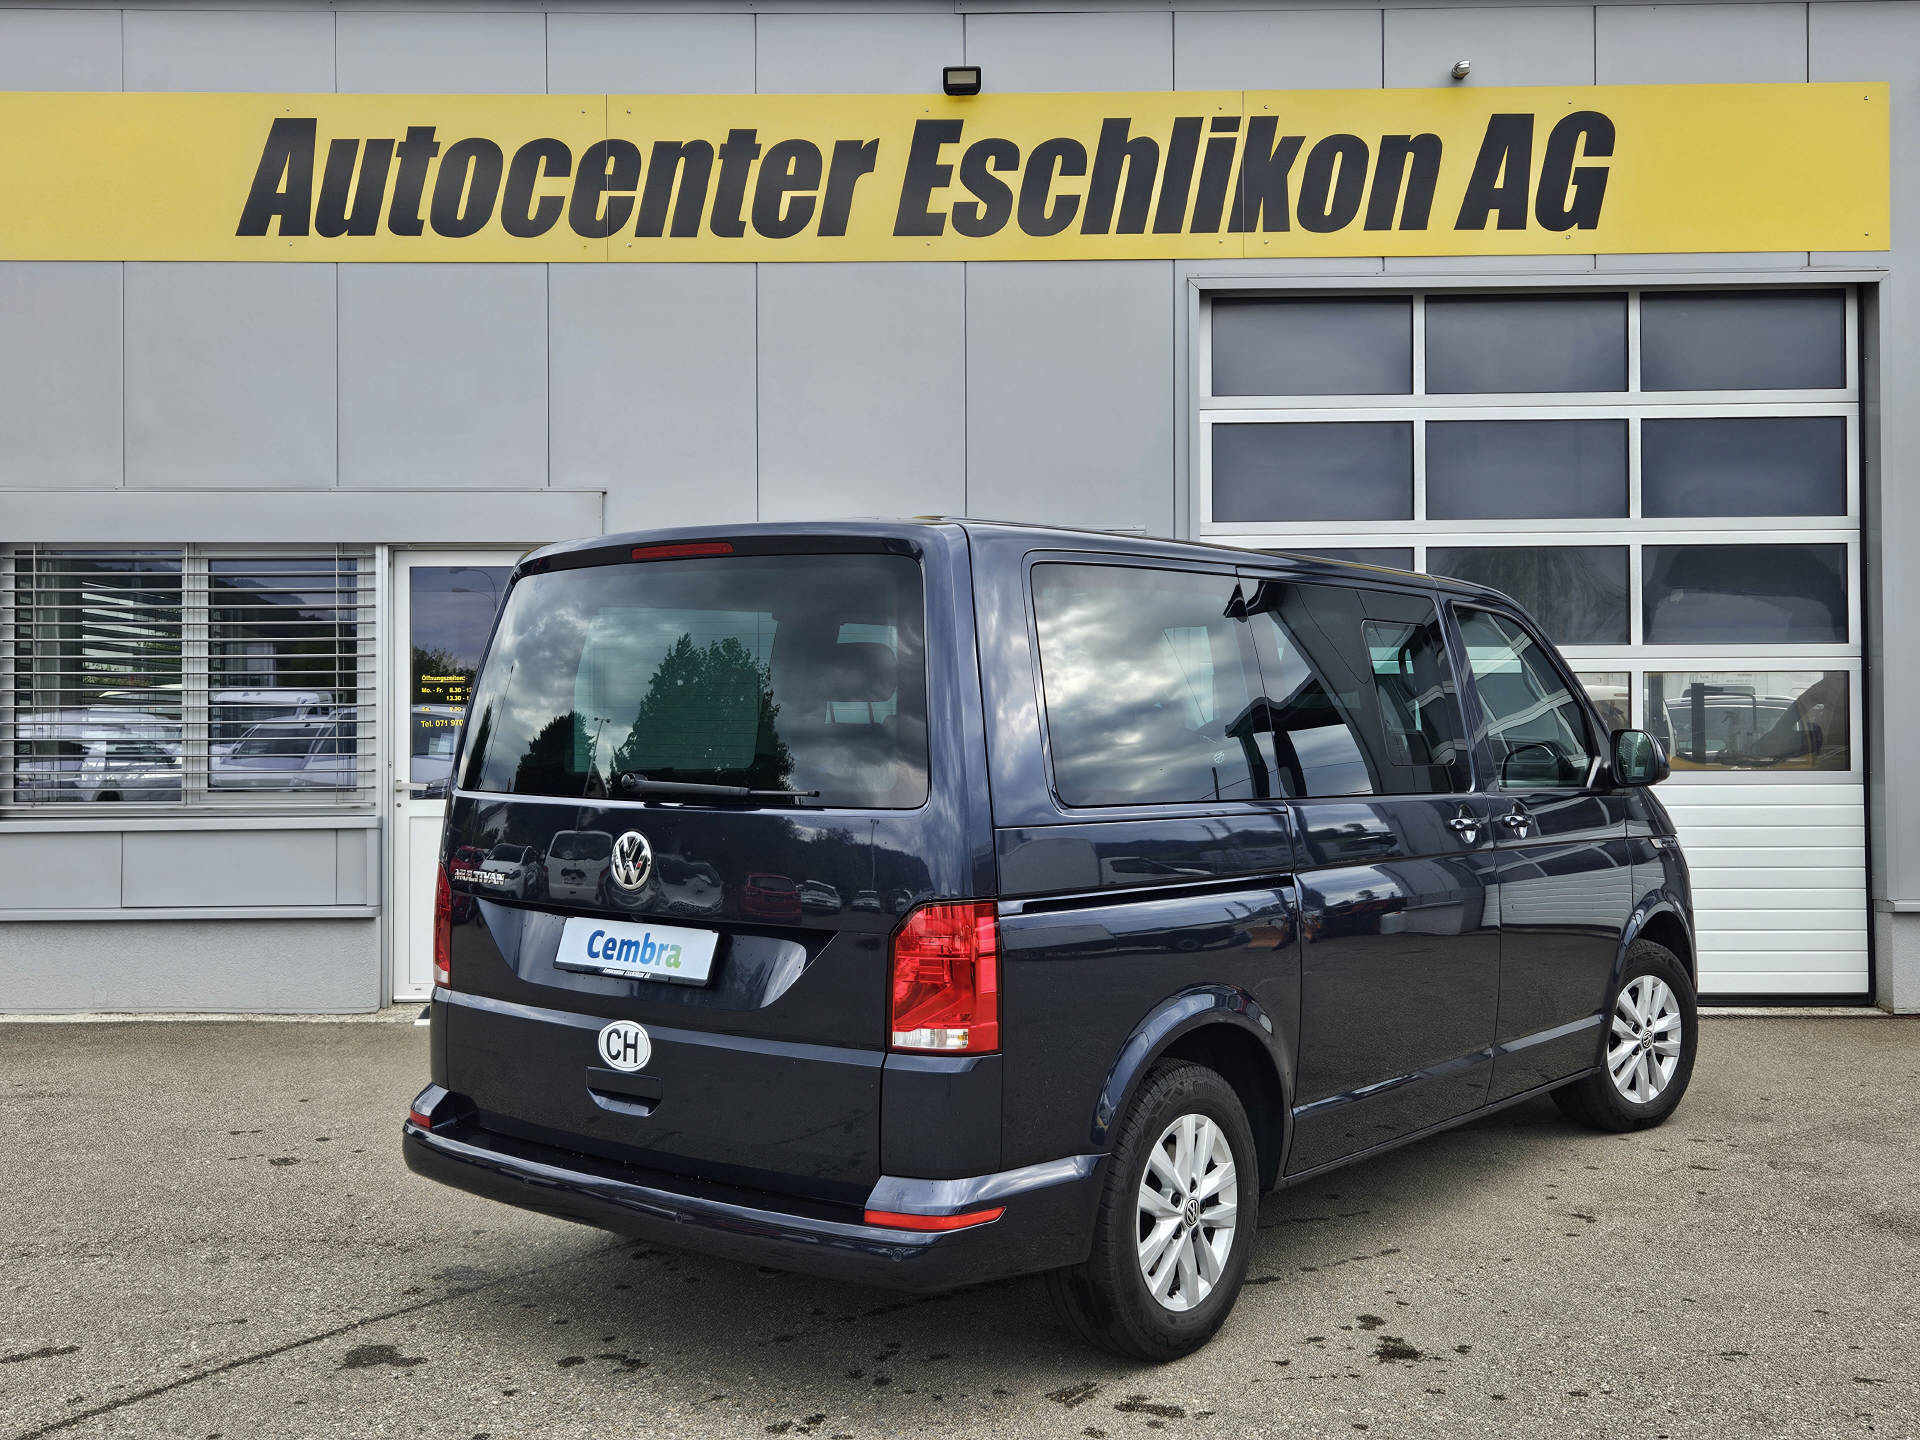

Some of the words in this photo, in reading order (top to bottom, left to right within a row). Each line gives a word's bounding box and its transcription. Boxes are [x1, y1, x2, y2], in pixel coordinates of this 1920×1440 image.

[236, 117, 880, 239] Autocenter
[893, 115, 1443, 238] Eschlikon
[1454, 111, 1616, 232] AG
[420, 720, 434, 728] Tel.
[435, 719, 449, 727] 071
[454, 868, 506, 886] MULTIVAN
[587, 929, 681, 969] Cembra
[606, 1027, 640, 1064] CH
